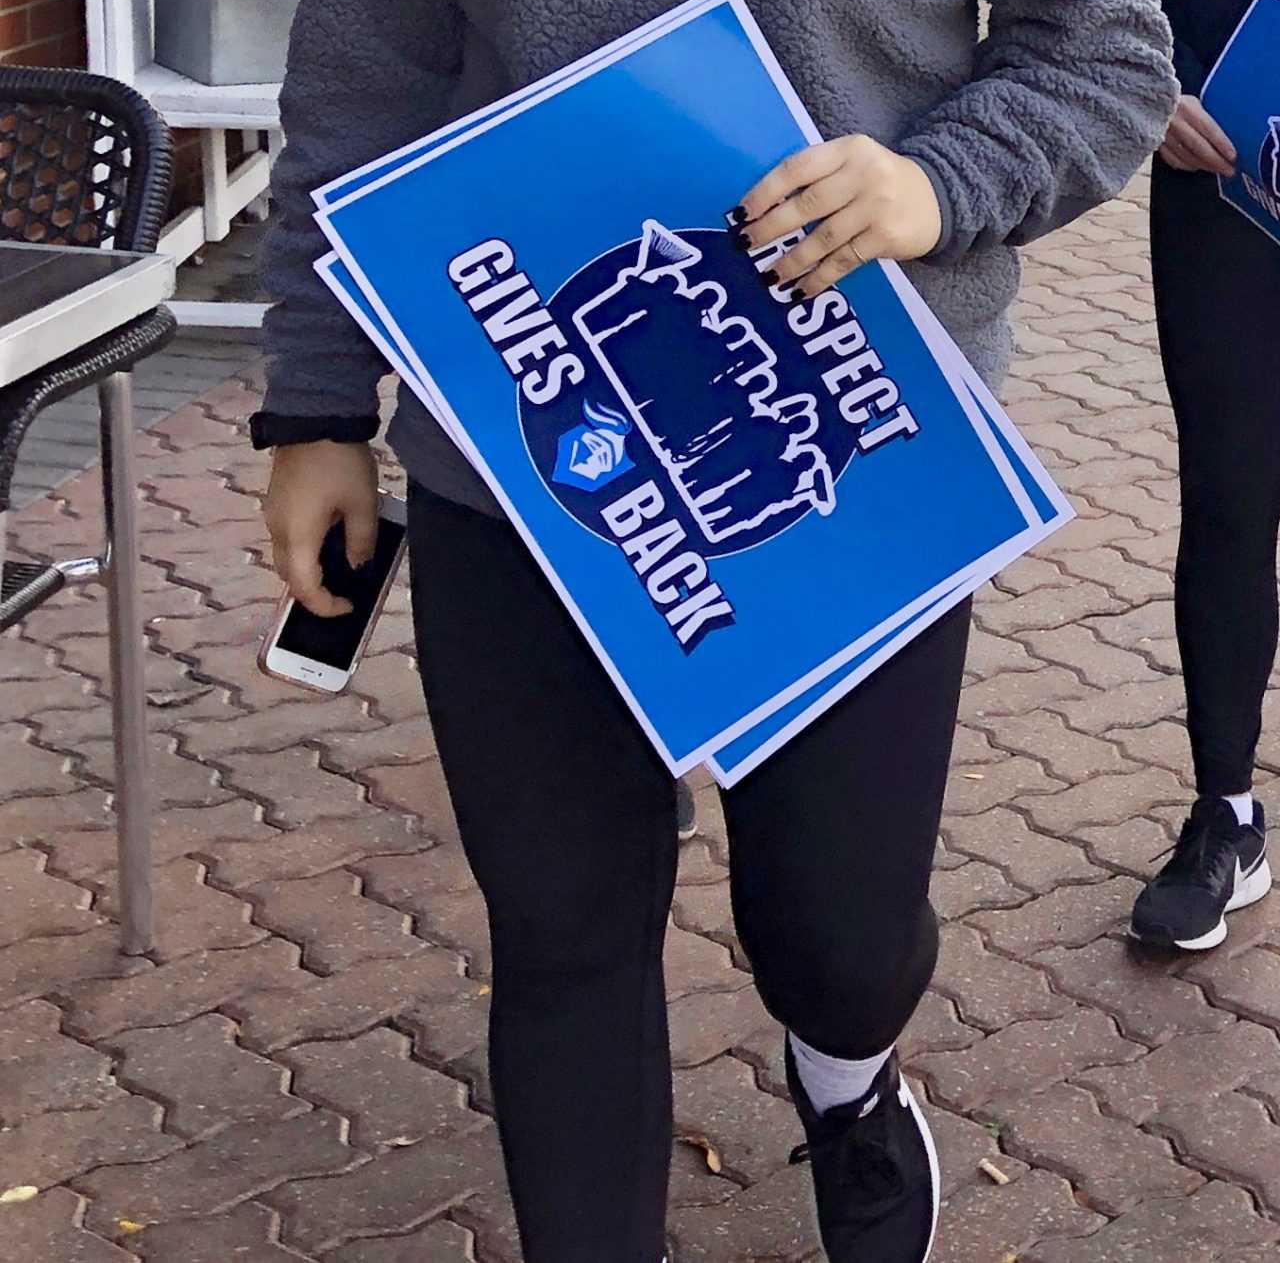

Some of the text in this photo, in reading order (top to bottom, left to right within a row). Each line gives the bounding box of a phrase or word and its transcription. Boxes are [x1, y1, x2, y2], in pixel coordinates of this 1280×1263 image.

[448, 238, 733, 646] GIVES BACK
[725, 210, 920, 451] RSPECT
